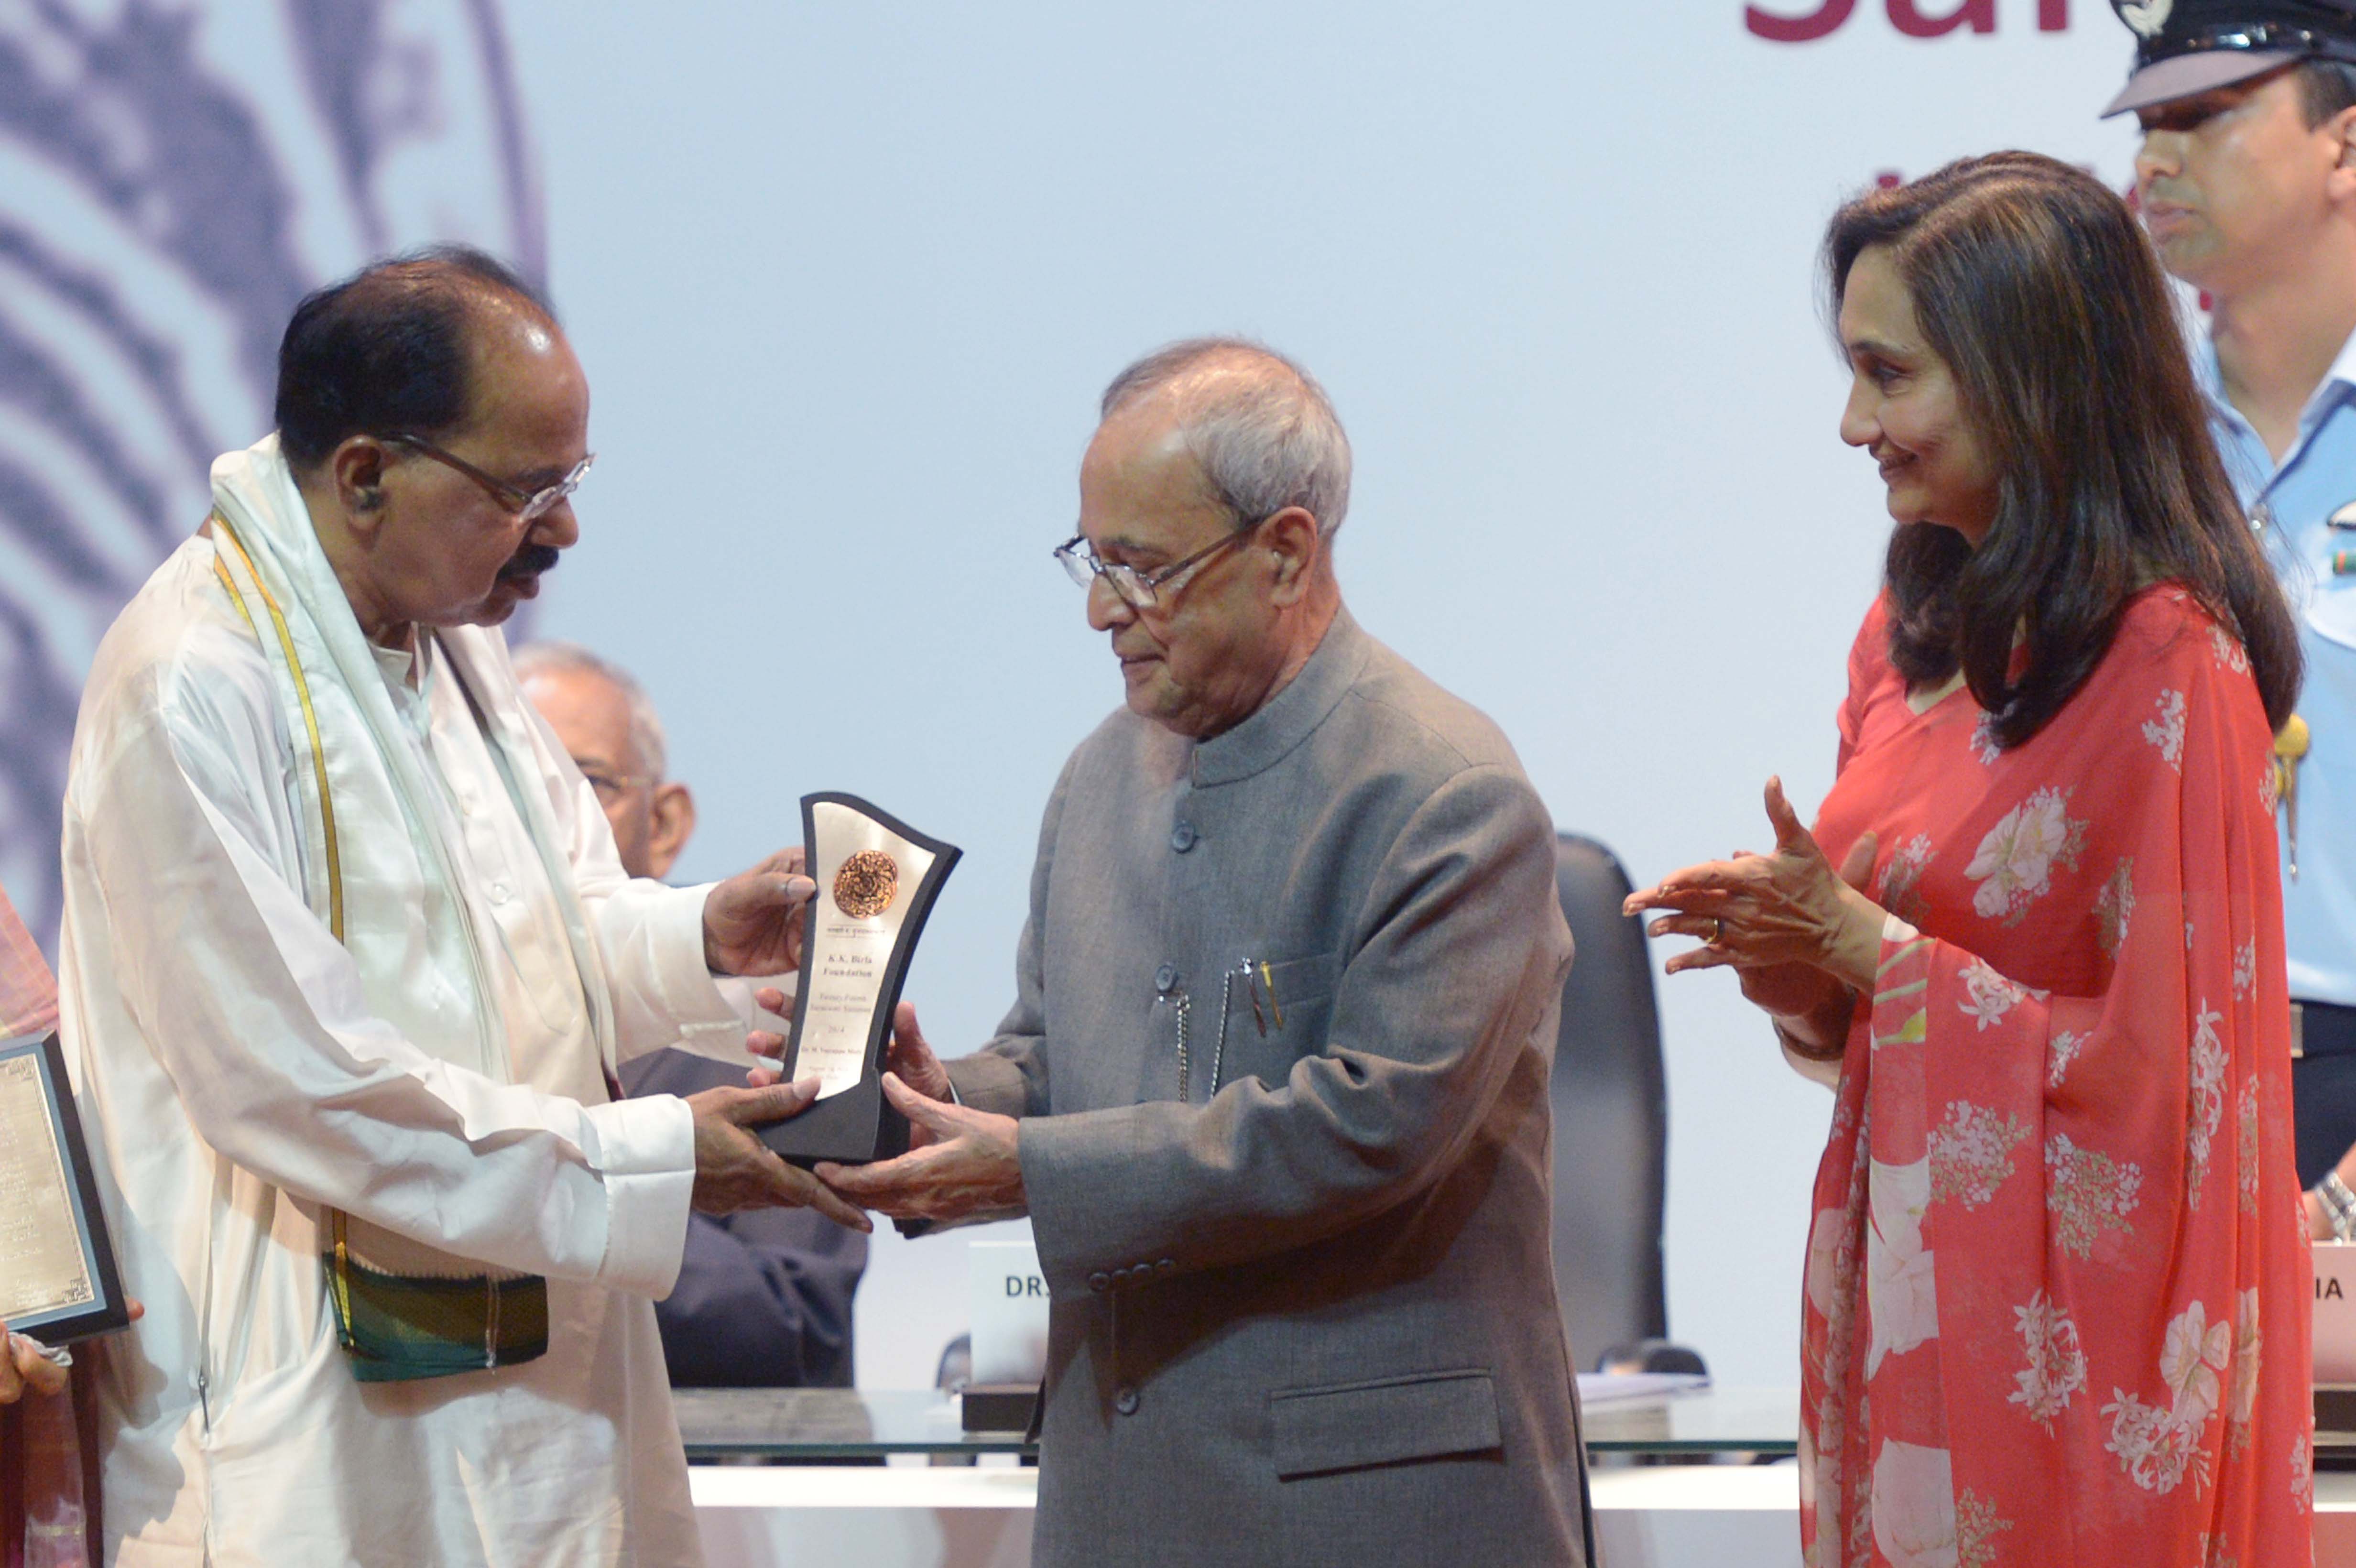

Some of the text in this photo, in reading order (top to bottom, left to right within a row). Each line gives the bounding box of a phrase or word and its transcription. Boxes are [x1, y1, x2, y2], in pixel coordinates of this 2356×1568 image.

[851, 955, 873, 964] Birla
[823, 967, 873, 978] Foundation
[1006, 1275, 1050, 1297] DR.
